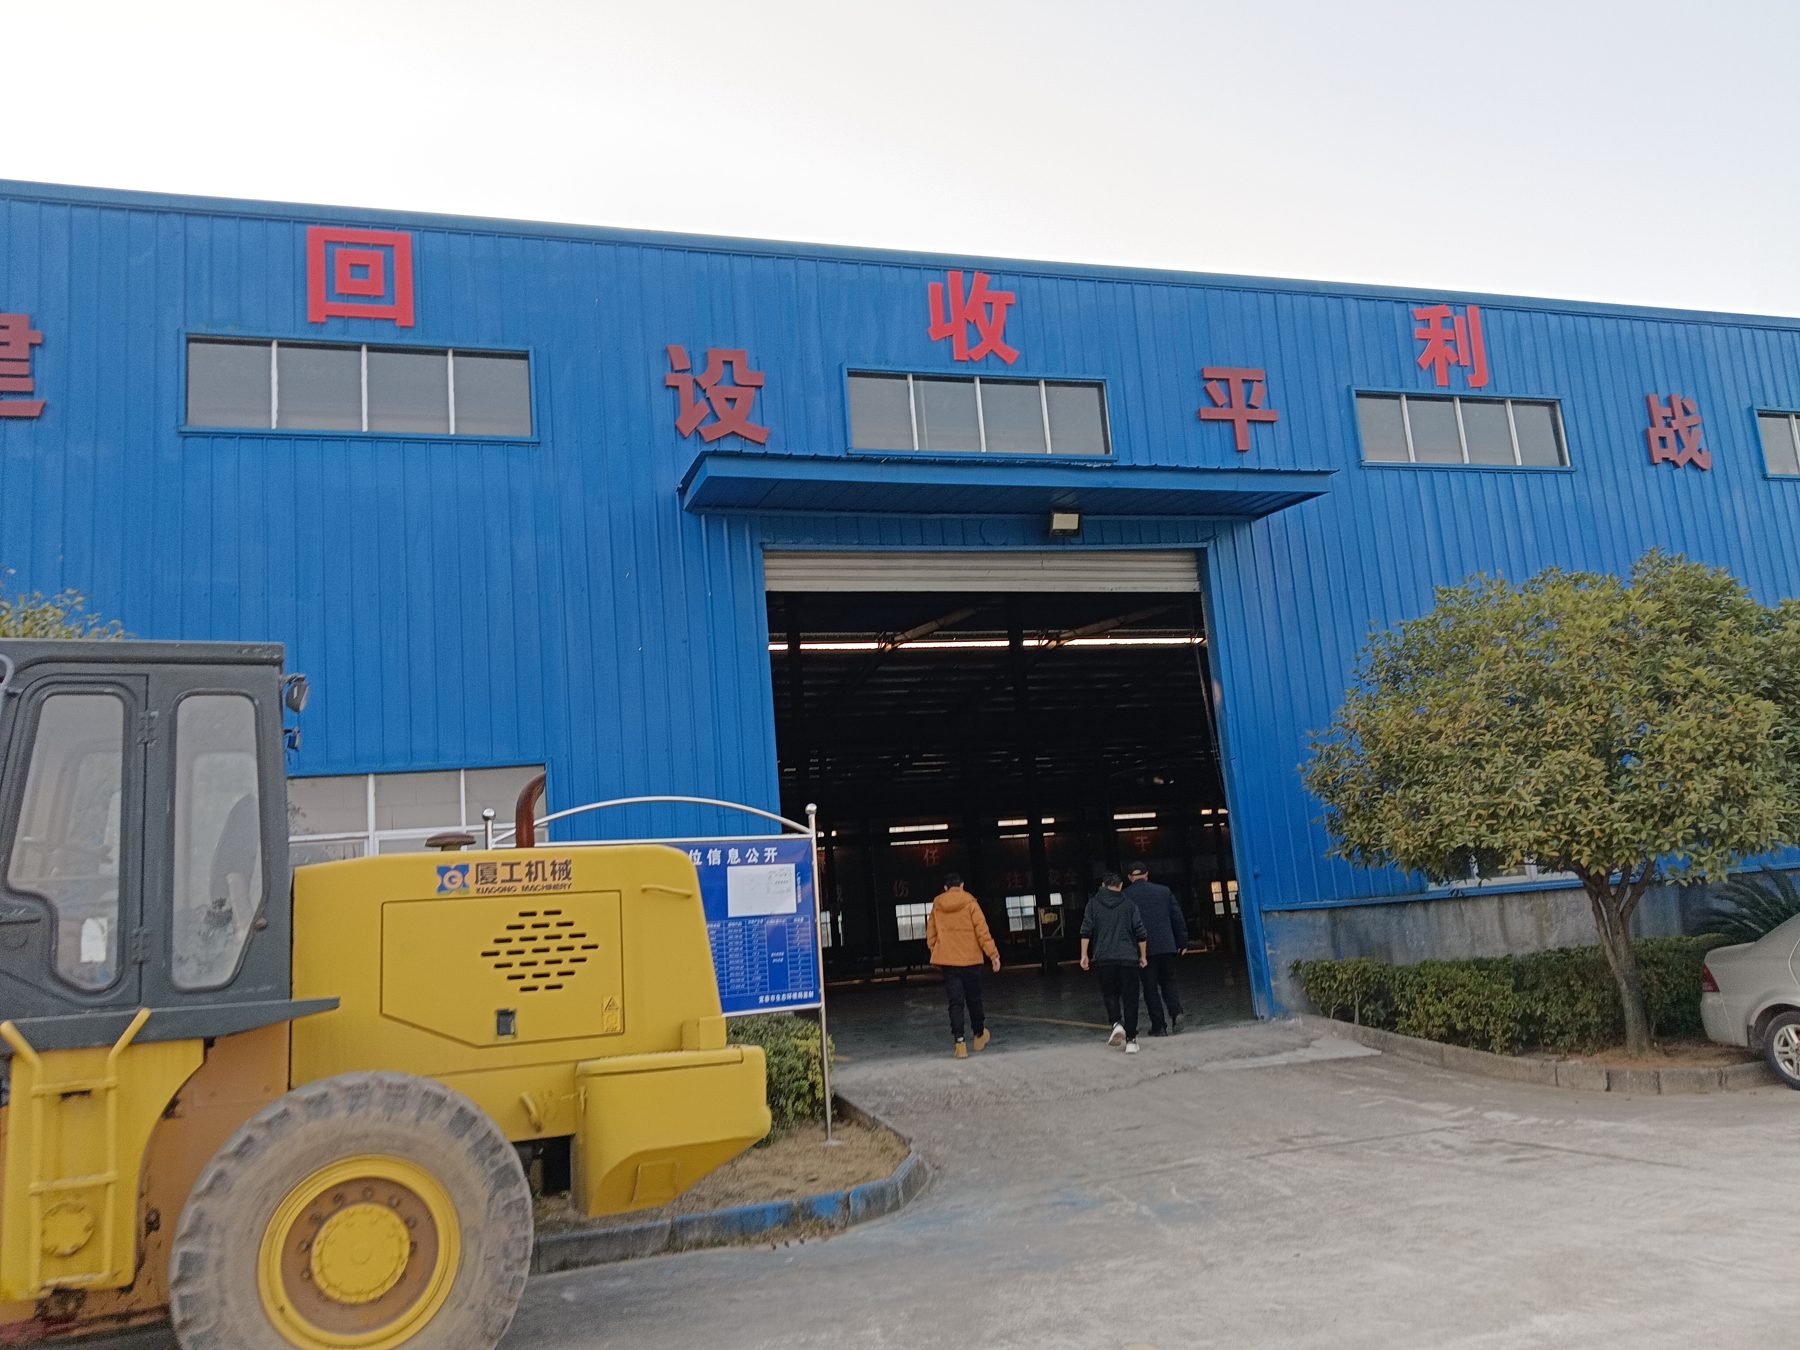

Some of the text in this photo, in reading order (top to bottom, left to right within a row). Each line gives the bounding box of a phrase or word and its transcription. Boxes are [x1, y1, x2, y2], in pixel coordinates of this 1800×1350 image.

[306, 226, 1489, 388] 回 收 利
[664, 344, 1712, 472] 设 平 战
[475, 859, 573, 884] 厦工机械
[521, 883, 573, 892] MACHINERY
